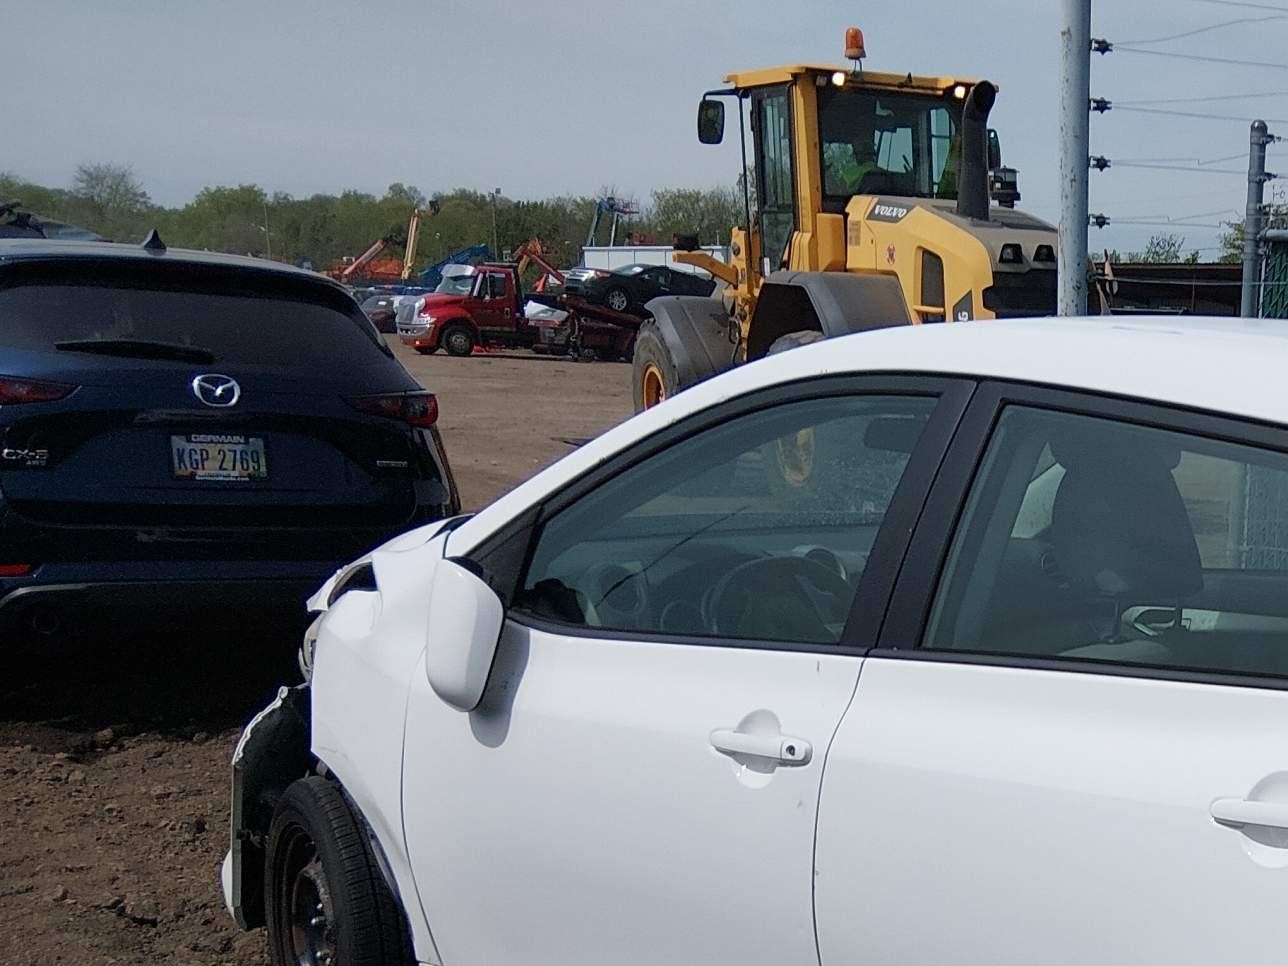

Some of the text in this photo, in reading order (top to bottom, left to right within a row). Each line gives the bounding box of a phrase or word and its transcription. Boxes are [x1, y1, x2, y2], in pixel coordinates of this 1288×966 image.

[874, 204, 908, 218] VOLVO
[191, 433, 246, 443] GERMAIN
[2, 448, 49, 460] CX-5
[176, 447, 261, 472] KGP 2769
